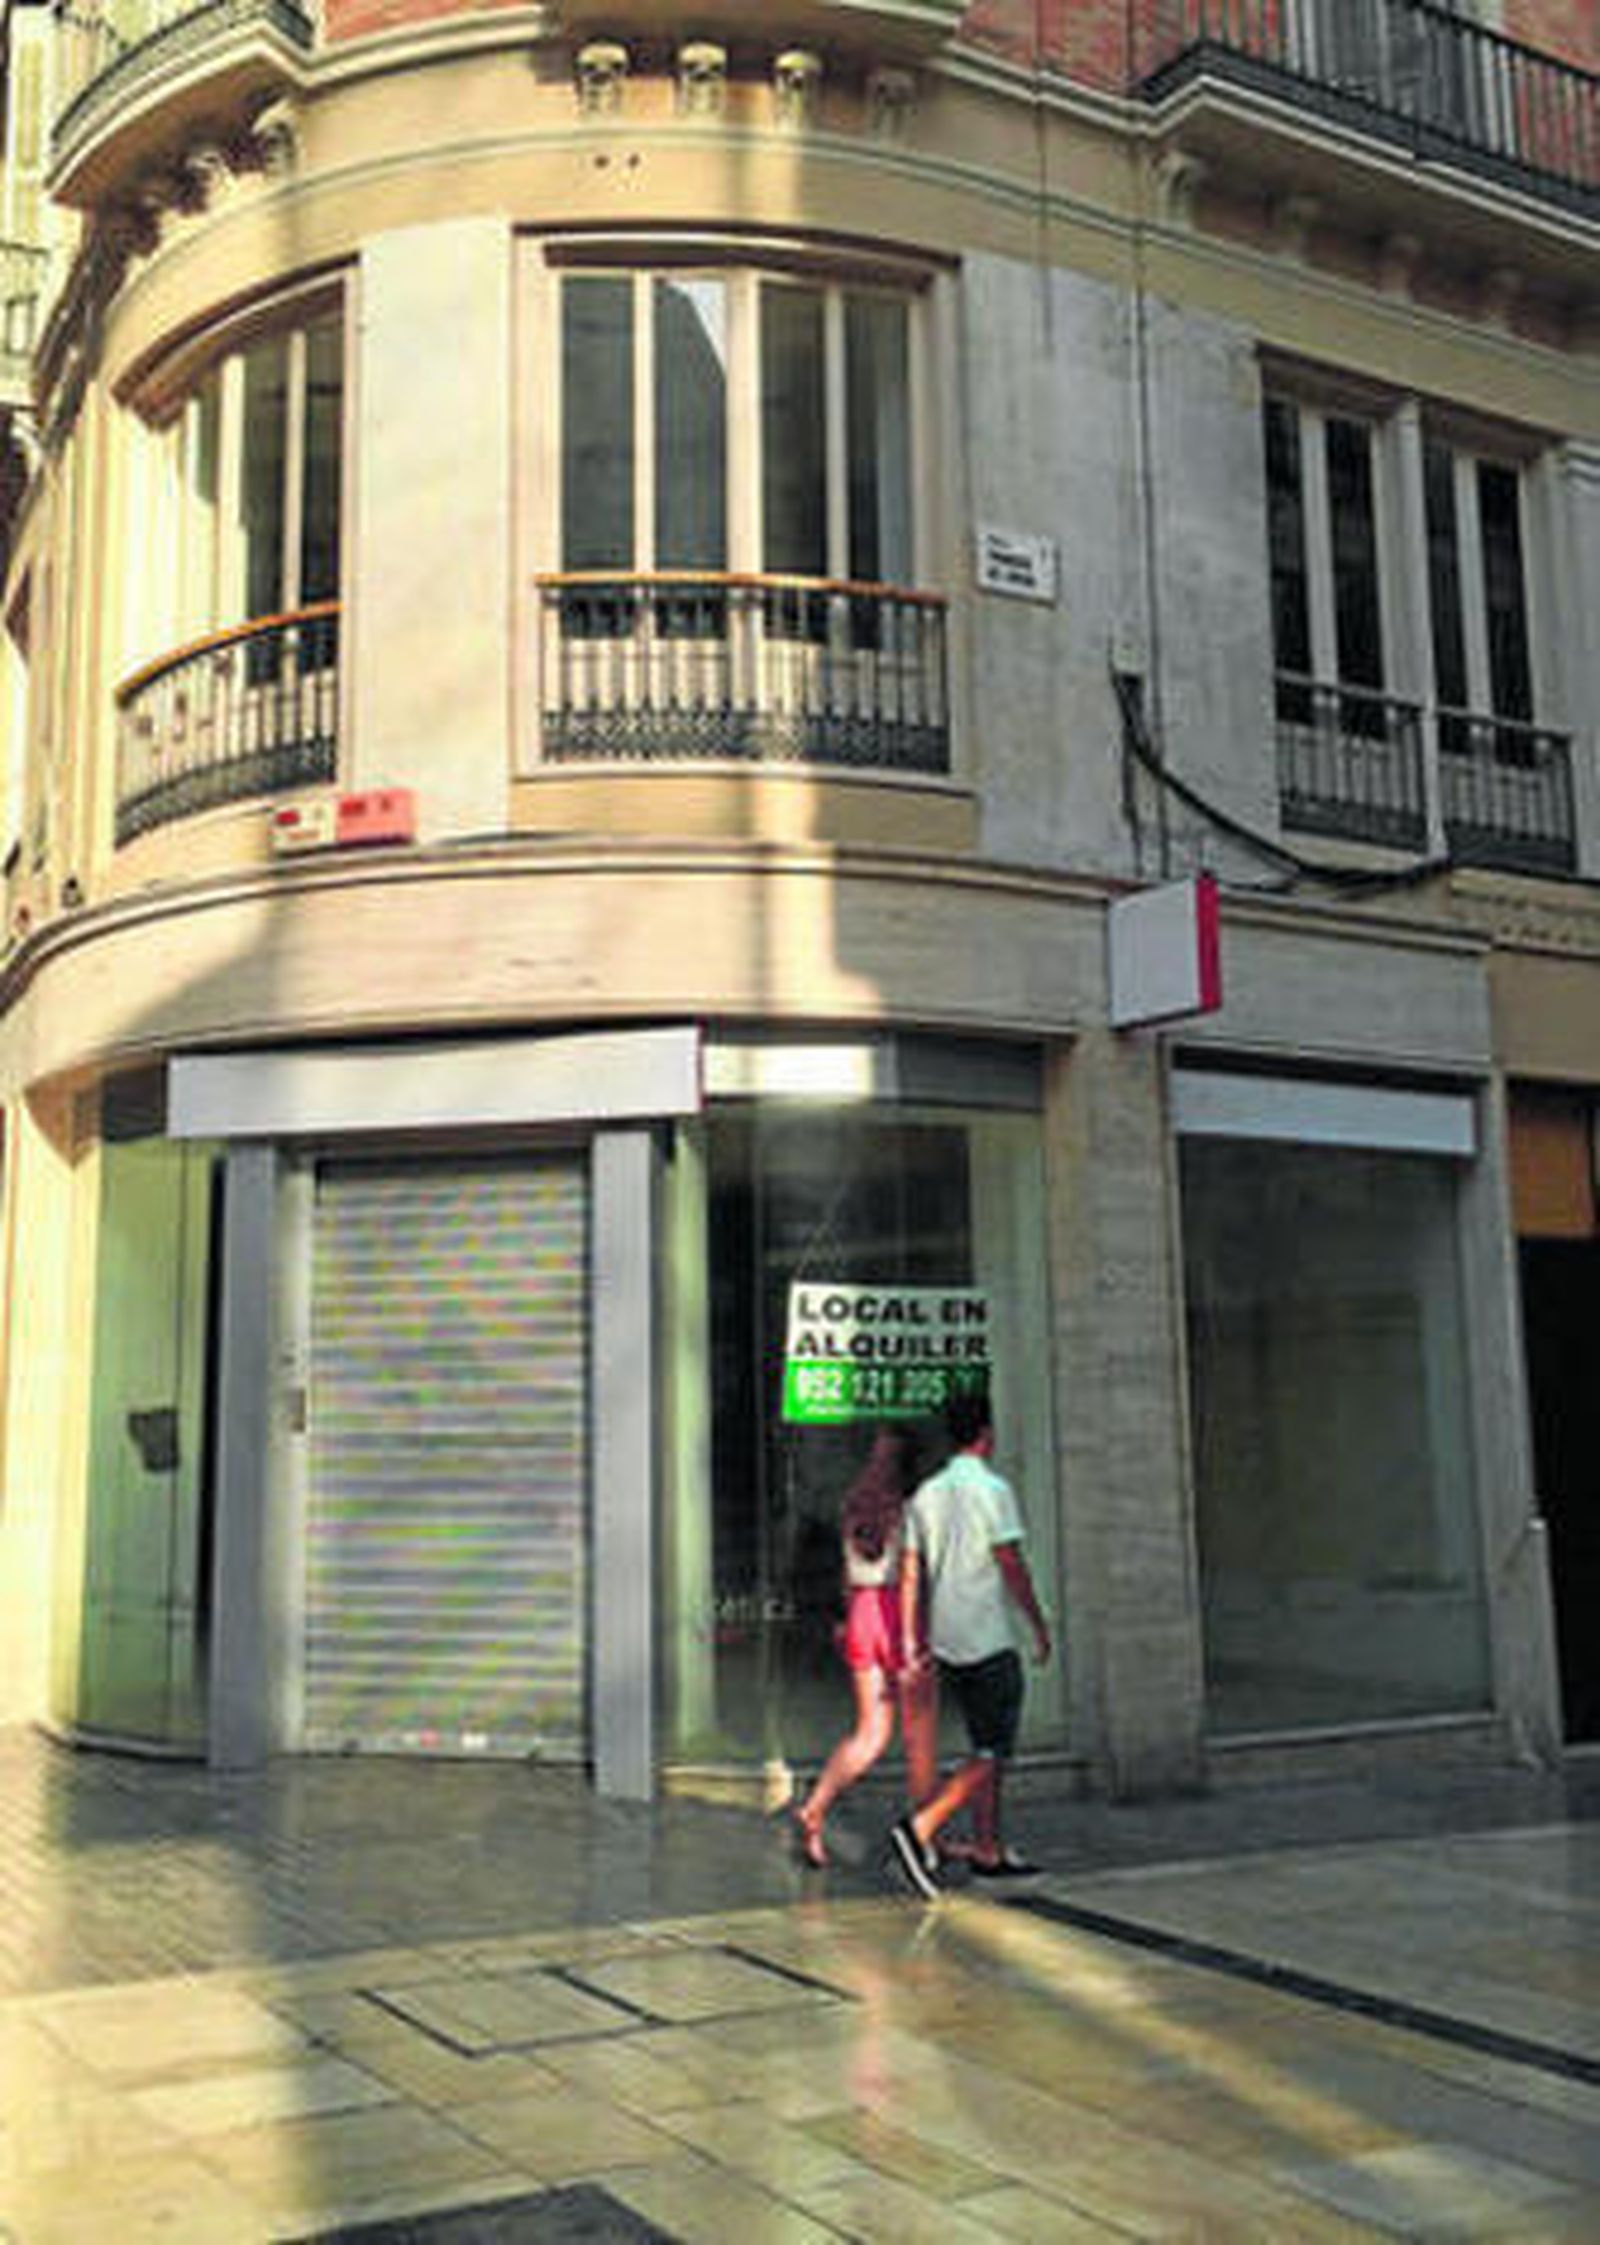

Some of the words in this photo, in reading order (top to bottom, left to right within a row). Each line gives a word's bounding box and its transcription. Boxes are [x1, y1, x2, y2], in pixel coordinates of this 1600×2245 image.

[797, 1292, 929, 1324] LOCAL
[940, 1297, 988, 1325] EN
[795, 1331, 988, 1358] ALQUILER
